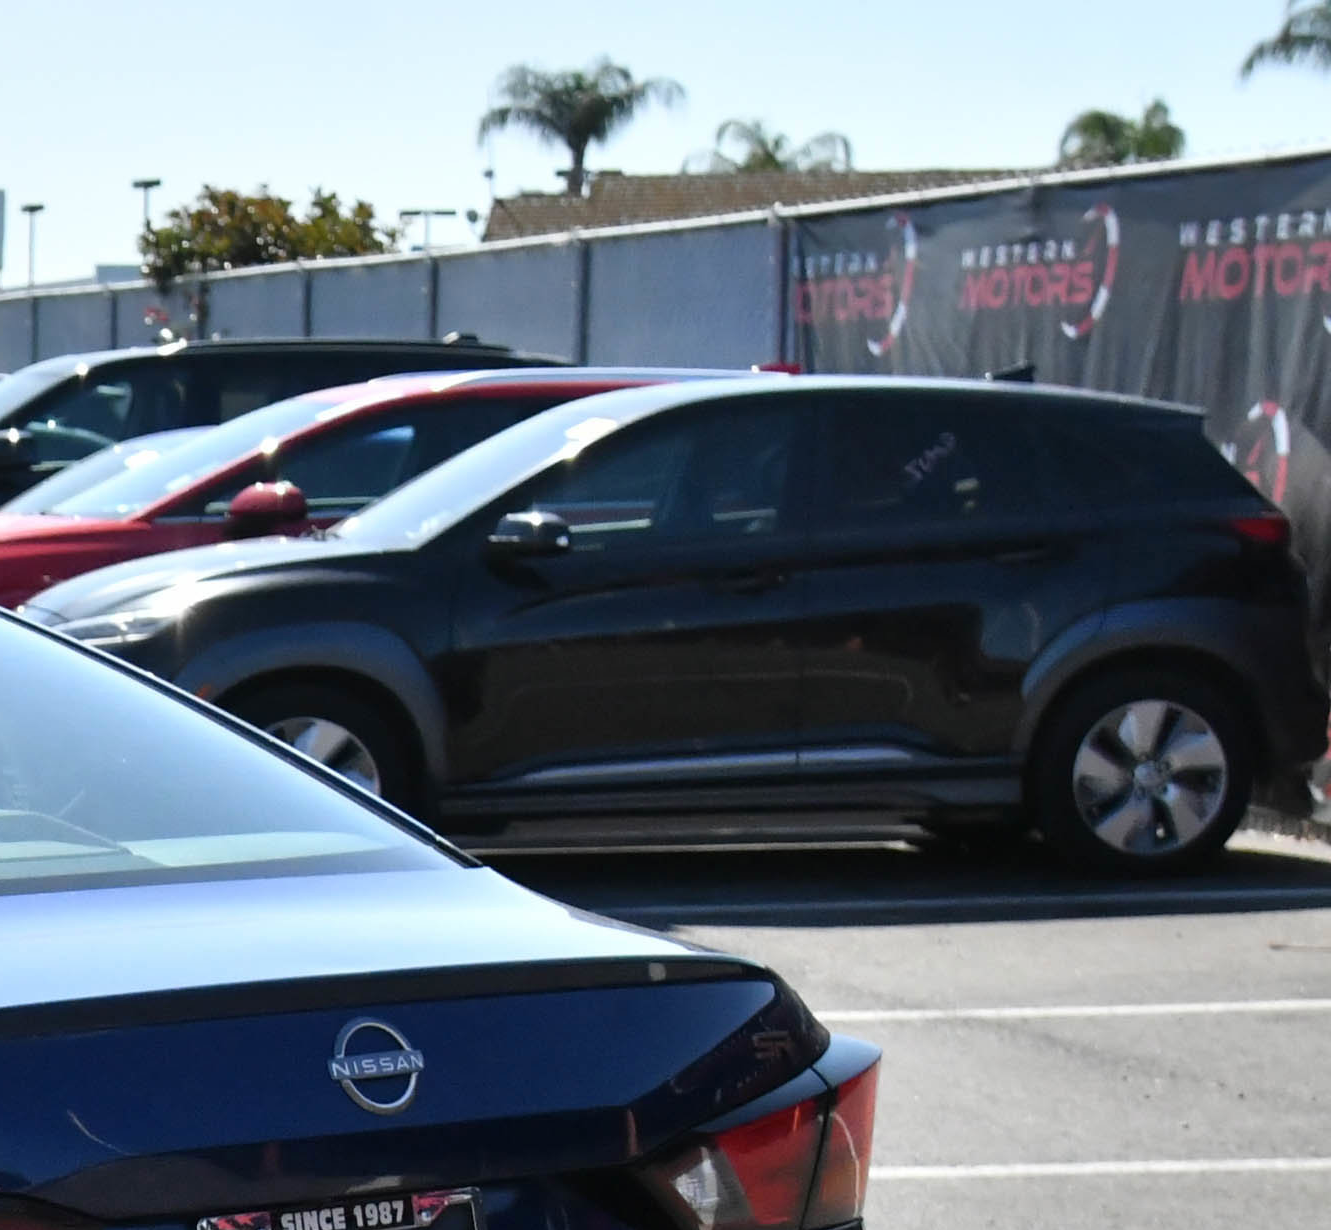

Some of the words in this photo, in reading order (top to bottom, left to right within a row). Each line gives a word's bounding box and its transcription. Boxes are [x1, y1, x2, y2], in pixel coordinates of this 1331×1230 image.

[961, 239, 1075, 268] WESTERN
[957, 261, 1094, 311] MOTORS
[1180, 240, 1331, 303] MOTOR
[331, 1055, 424, 1077] NISSAN
[353, 1199, 405, 1229] 1987
